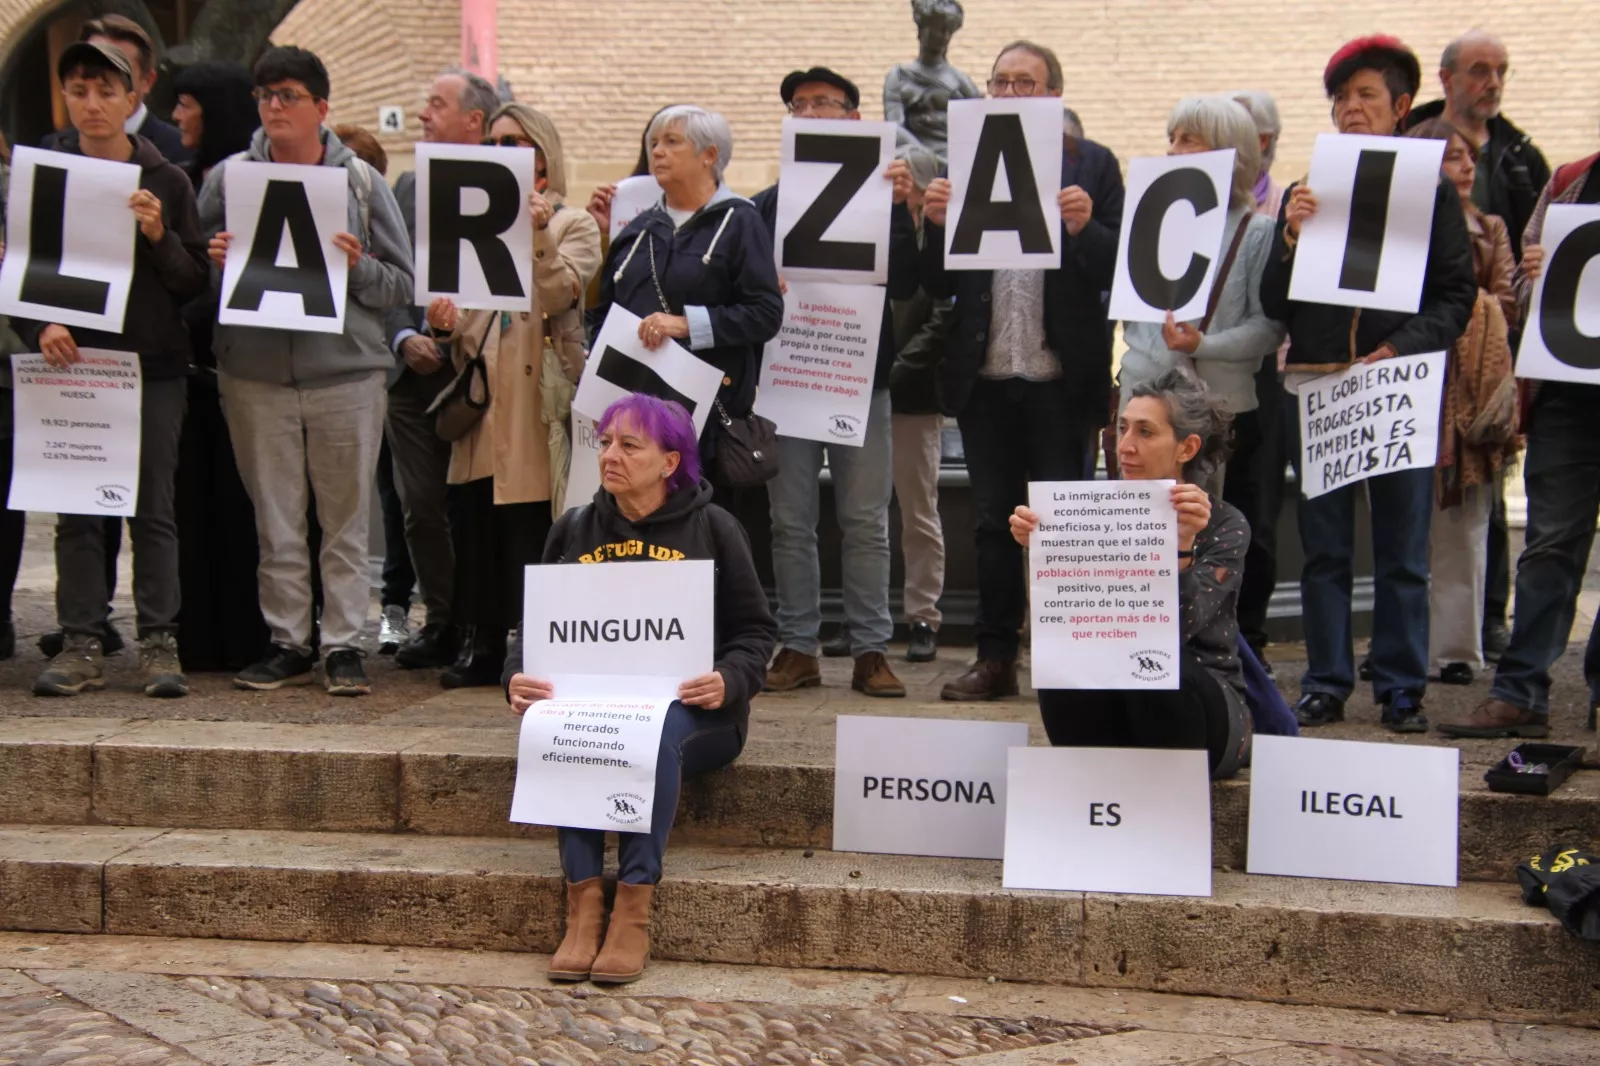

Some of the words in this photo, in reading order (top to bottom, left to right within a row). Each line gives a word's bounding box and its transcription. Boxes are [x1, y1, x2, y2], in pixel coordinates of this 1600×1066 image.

[385, 111, 399, 129] 4
[948, 113, 1055, 255] A
[782, 133, 881, 272] Z
[428, 158, 525, 298] R
[1338, 149, 1397, 293] I
[18, 163, 111, 316] L
[1127, 167, 1220, 311] C
[226, 179, 338, 319] A
[811, 302, 856, 316] población
[791, 313, 841, 328] inmigrante
[844, 321, 861, 330] que
[782, 326, 814, 337] trabaja
[817, 331, 832, 339] por
[835, 332, 867, 344] cuenta
[781, 339, 810, 349] propia
[821, 343, 844, 354] tiene
[847, 348, 864, 357] una
[790, 354, 829, 365] empresa
[832, 360, 852, 368] crea
[74, 367, 129, 379] EXTRANJERA
[770, 364, 832, 379] directamente
[835, 373, 868, 384] nuevos
[35, 378, 86, 387] SEGURIDAD
[89, 380, 120, 389] SOCIAL
[772, 378, 808, 389] puestos
[811, 382, 822, 390] de
[825, 383, 861, 397] trabajo.
[1307, 391, 1326, 416] EL
[1331, 362, 1429, 402] GOBIERNO
[60, 391, 96, 399] HUESCA
[1308, 393, 1413, 439] PROGRESISTA
[70, 421, 111, 430] personas
[69, 443, 102, 451] mujeres
[1307, 424, 1374, 463] TAMBIEN
[1390, 418, 1416, 440] ES
[70, 453, 107, 462] hombres
[1323, 442, 1412, 489] RACISTA
[1053, 492, 1065, 500] La
[1069, 491, 1135, 502] inmigración
[1054, 507, 1150, 516] económicamente
[1039, 523, 1100, 532] beneficiosa
[1104, 524, 1113, 533] y,
[1117, 522, 1132, 531] los
[1136, 522, 1167, 530] datos
[1041, 538, 1094, 547] muestran
[1098, 539, 1119, 549] que
[1122, 537, 1131, 546] el
[1135, 537, 1164, 546] saldo
[1046, 553, 1130, 564] presupuestario
[1134, 553, 1147, 561] de
[1151, 552, 1160, 561] la
[1037, 568, 1090, 579] población
[1094, 568, 1155, 579] inmigrante
[1057, 583, 1104, 594] positivo,
[1108, 584, 1136, 594] pues,
[1140, 583, 1150, 592] al
[1044, 599, 1095, 608] contrario
[1099, 599, 1112, 608] de
[1115, 599, 1125, 607] lo
[1128, 600, 1149, 610] que
[1152, 599, 1164, 607] se
[1040, 615, 1066, 624] cree,
[1069, 615, 1113, 626] aportan
[1117, 613, 1139, 623] más
[1143, 614, 1156, 623] de
[1160, 614, 1170, 623] lo
[549, 617, 685, 644] NINGUNA
[1072, 630, 1092, 640] que
[1096, 629, 1137, 638] reciben
[567, 710, 574, 718] y
[577, 710, 632, 720] mantiene
[635, 713, 651, 722] los
[564, 723, 619, 734] mercados
[553, 736, 624, 751] funcionando
[542, 752, 632, 768] eficientemente.
[863, 775, 995, 804] PERSONA
[1301, 790, 1403, 819] ILEGAL
[1089, 802, 1122, 827] ES
